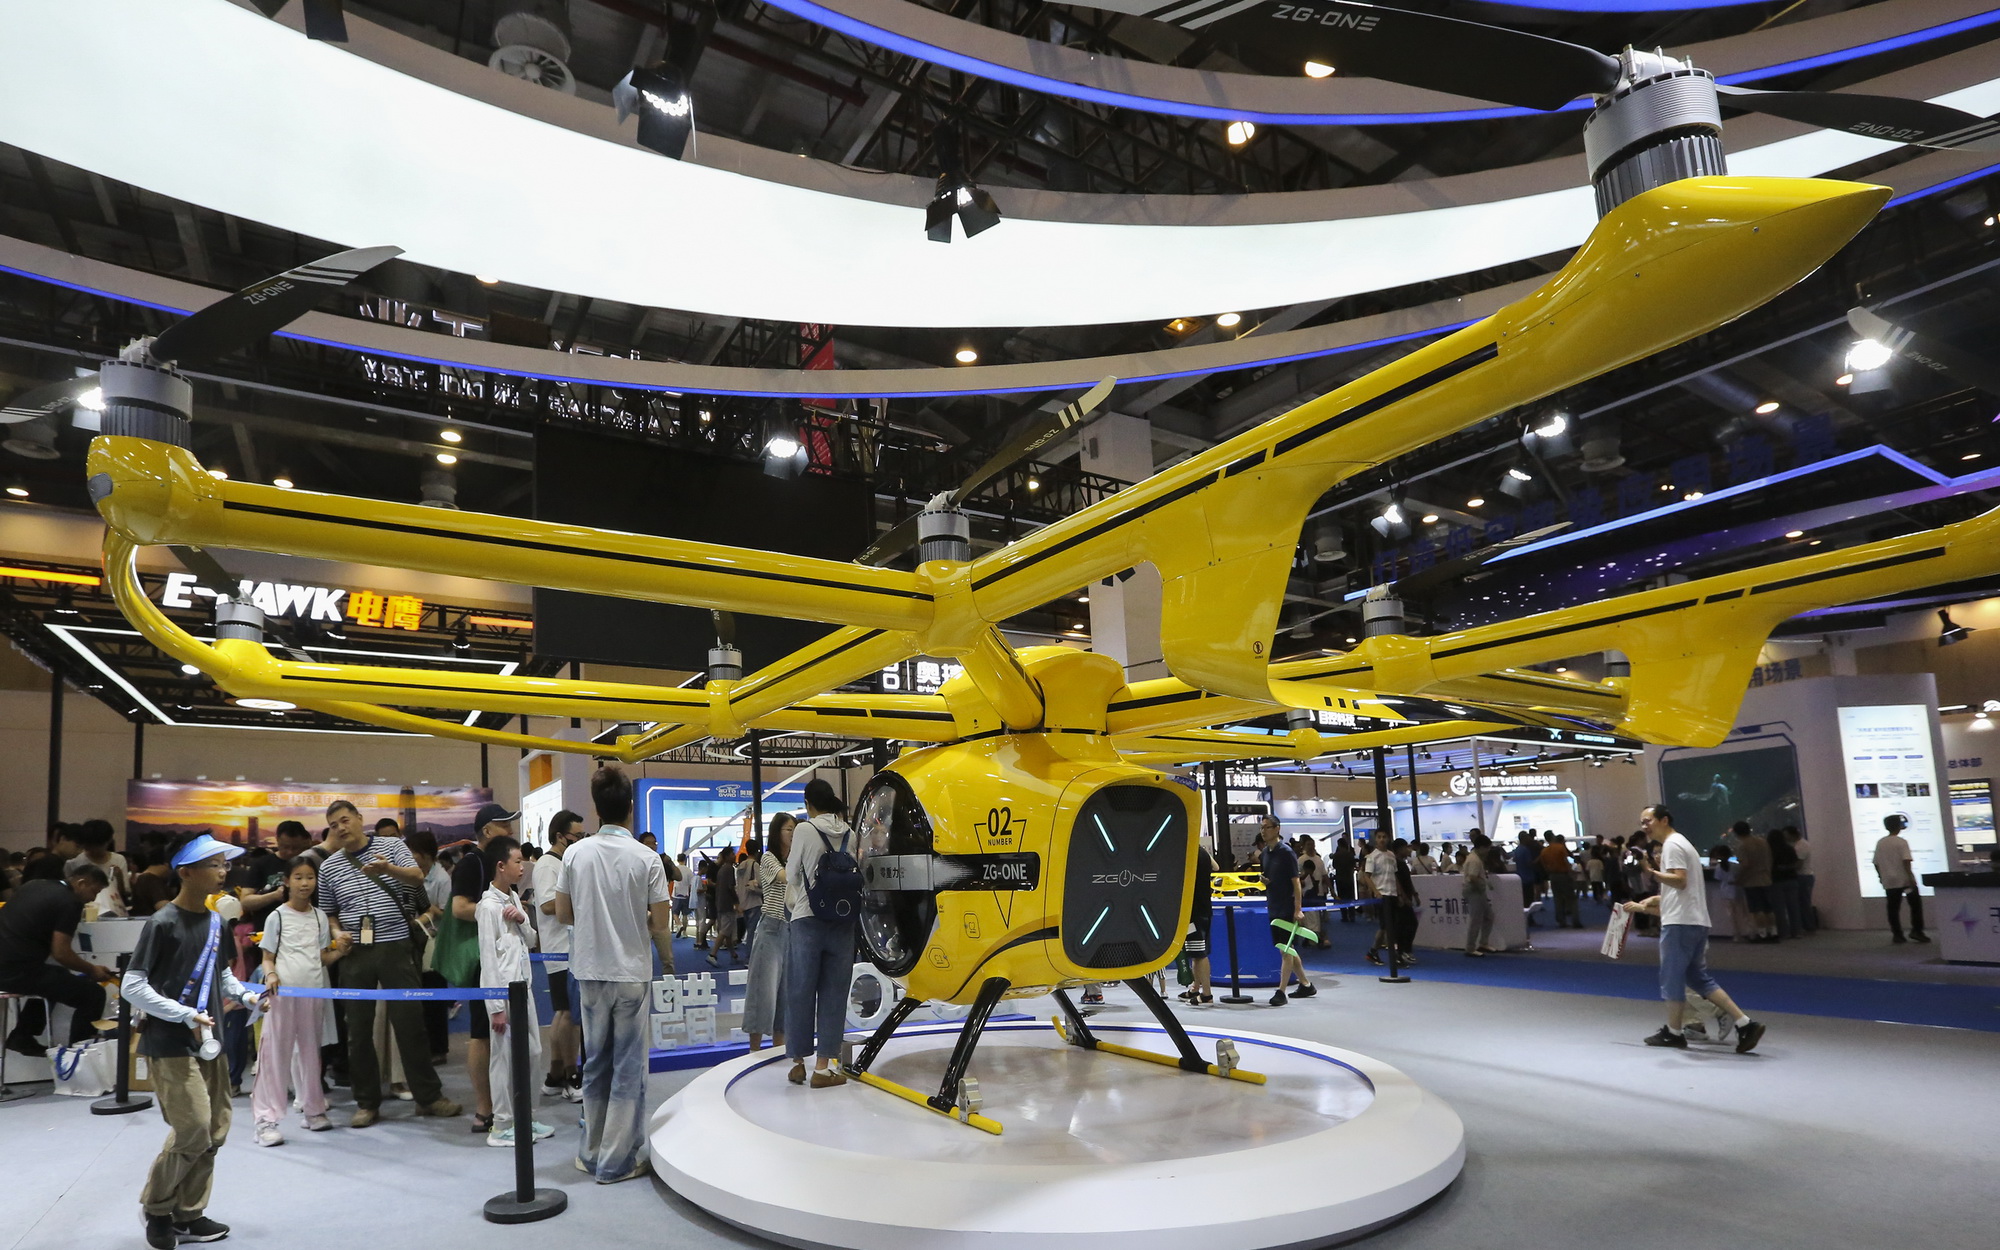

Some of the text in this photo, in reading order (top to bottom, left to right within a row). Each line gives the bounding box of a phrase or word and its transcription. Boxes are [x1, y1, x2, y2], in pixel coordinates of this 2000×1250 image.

[1271, 4, 1381, 31] ZG-ONE
[1848, 121, 1925, 140] ZG-ONE
[243, 280, 296, 305] ZG-ONE
[346, 590, 424, 631] 电鹰
[987, 806, 1013, 837] 02
[987, 837, 1013, 846] NUMBER
[982, 863, 1028, 881] ZG-ONE
